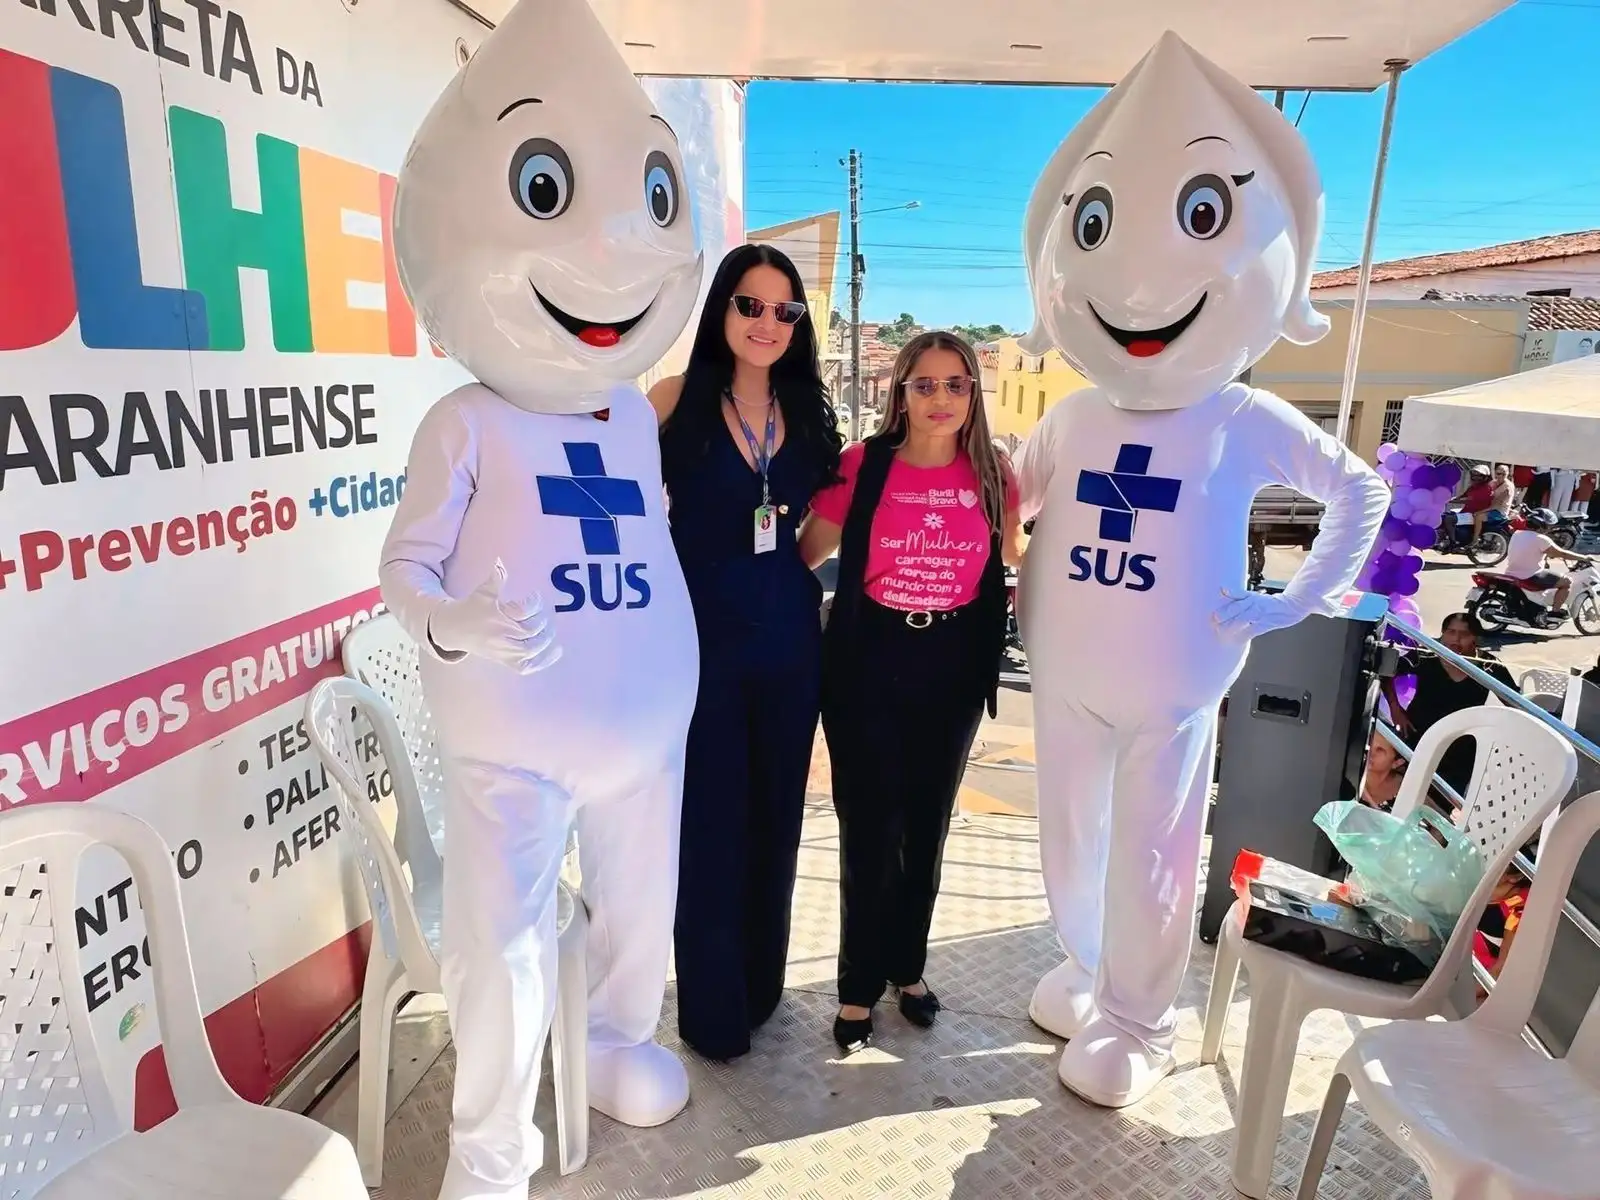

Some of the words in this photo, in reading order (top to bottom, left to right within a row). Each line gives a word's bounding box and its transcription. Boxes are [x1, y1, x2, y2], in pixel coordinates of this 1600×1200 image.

[276, 47, 323, 107] DA
[0, 384, 378, 491] ARANHENSE
[929, 497, 958, 506] Bravo
[880, 537, 905, 548] Ser
[906, 529, 977, 555] Mulher
[895, 556, 957, 568] carregar
[956, 558, 966, 567] a
[939, 570, 956, 580] do
[1068, 544, 1157, 592] SUS
[551, 563, 651, 612] SUS
[881, 576, 925, 591] mundo
[926, 583, 953, 593] com
[954, 584, 963, 594] a
[202, 602, 388, 712] GRATUIT
